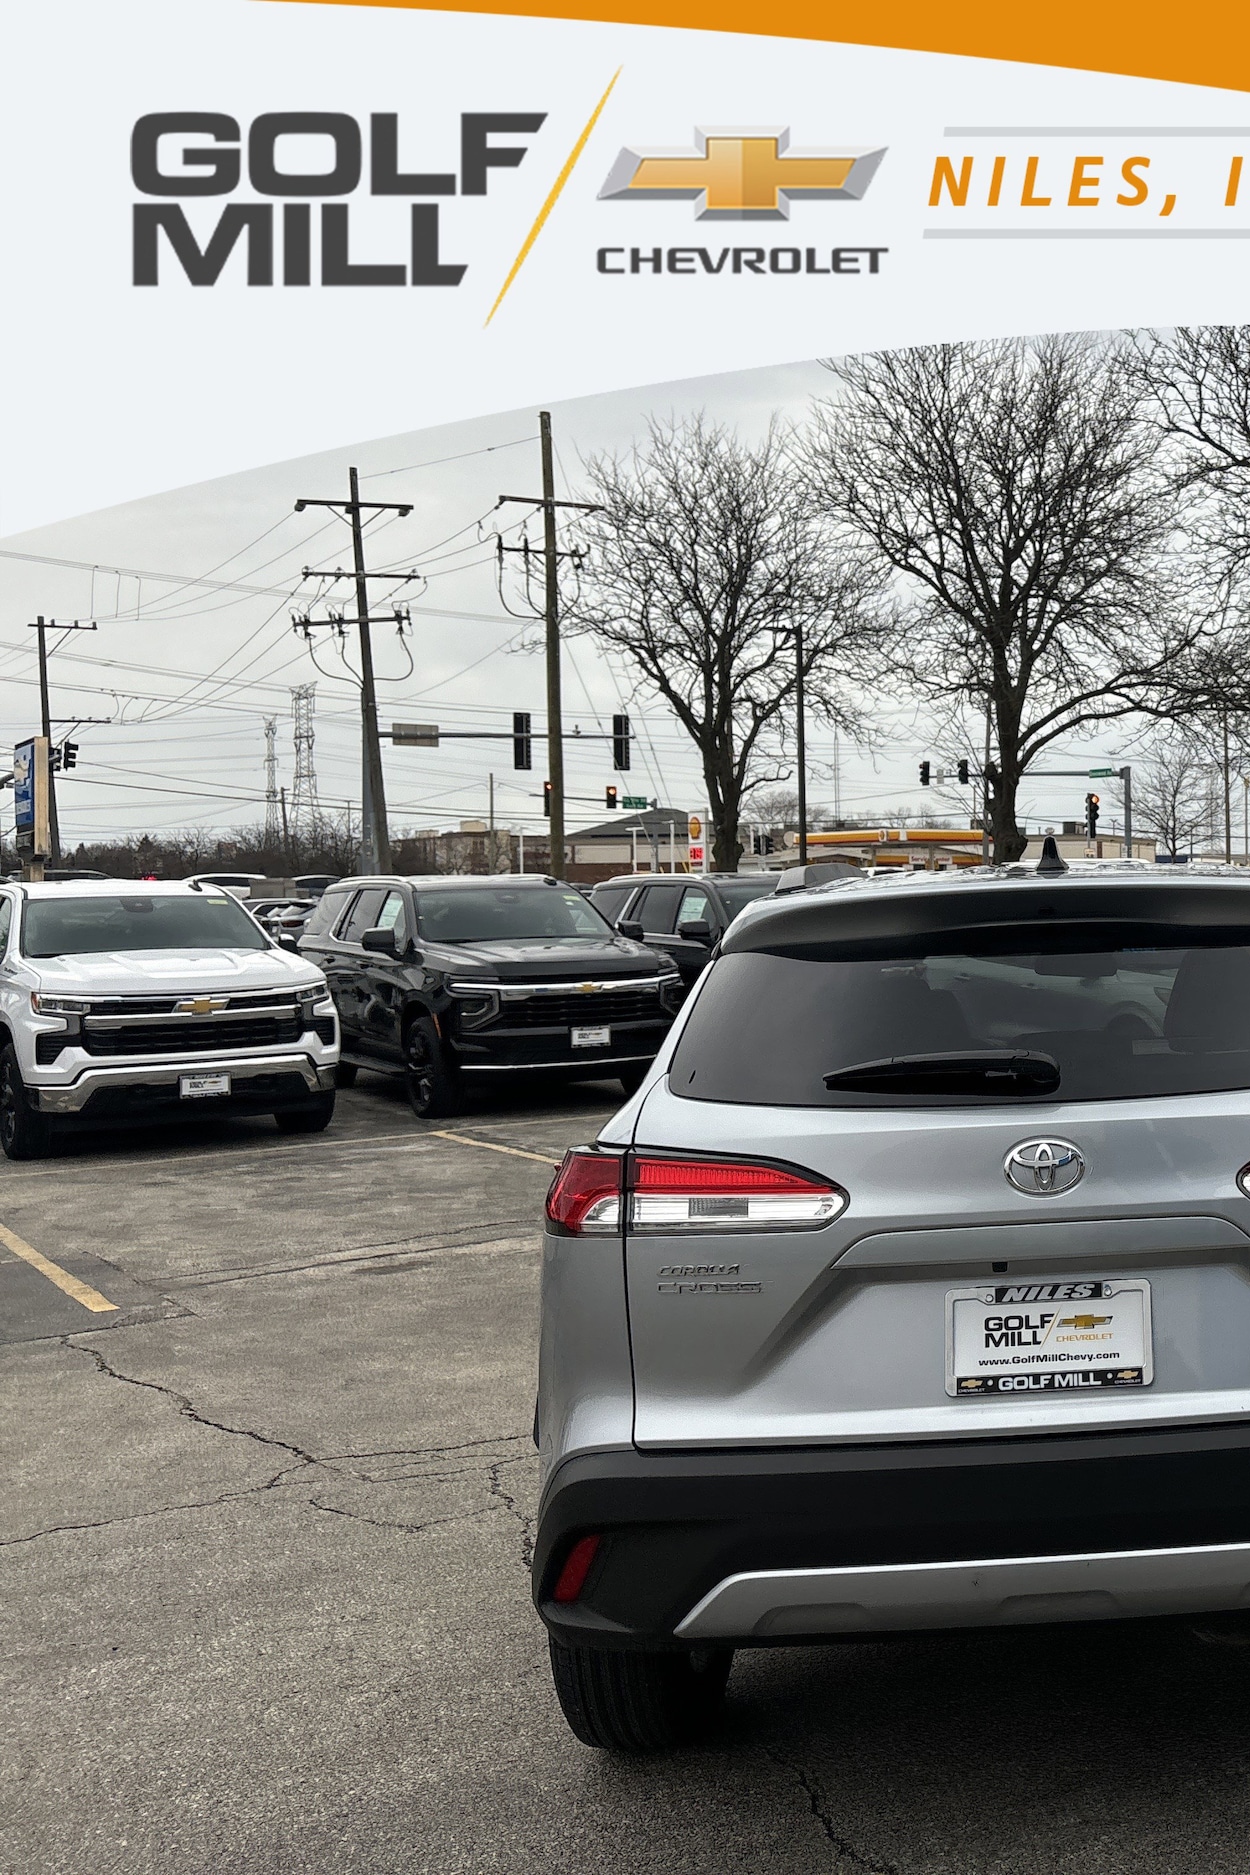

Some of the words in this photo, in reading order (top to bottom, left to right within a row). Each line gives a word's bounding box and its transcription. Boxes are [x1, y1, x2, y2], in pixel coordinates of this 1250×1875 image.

[657, 1263, 741, 1277] COROLLA
[657, 1281, 763, 1295] CROSS
[1001, 1283, 1096, 1302] NILES
[984, 1313, 1055, 1332] GOLF
[984, 1331, 1042, 1348] MILL
[1056, 1332, 1114, 1342] CHEVROLET
[978, 1351, 1120, 1367] www.GolfMillChevy.com
[998, 1375, 1050, 1391] GOLF
[1054, 1372, 1102, 1387] MILL
